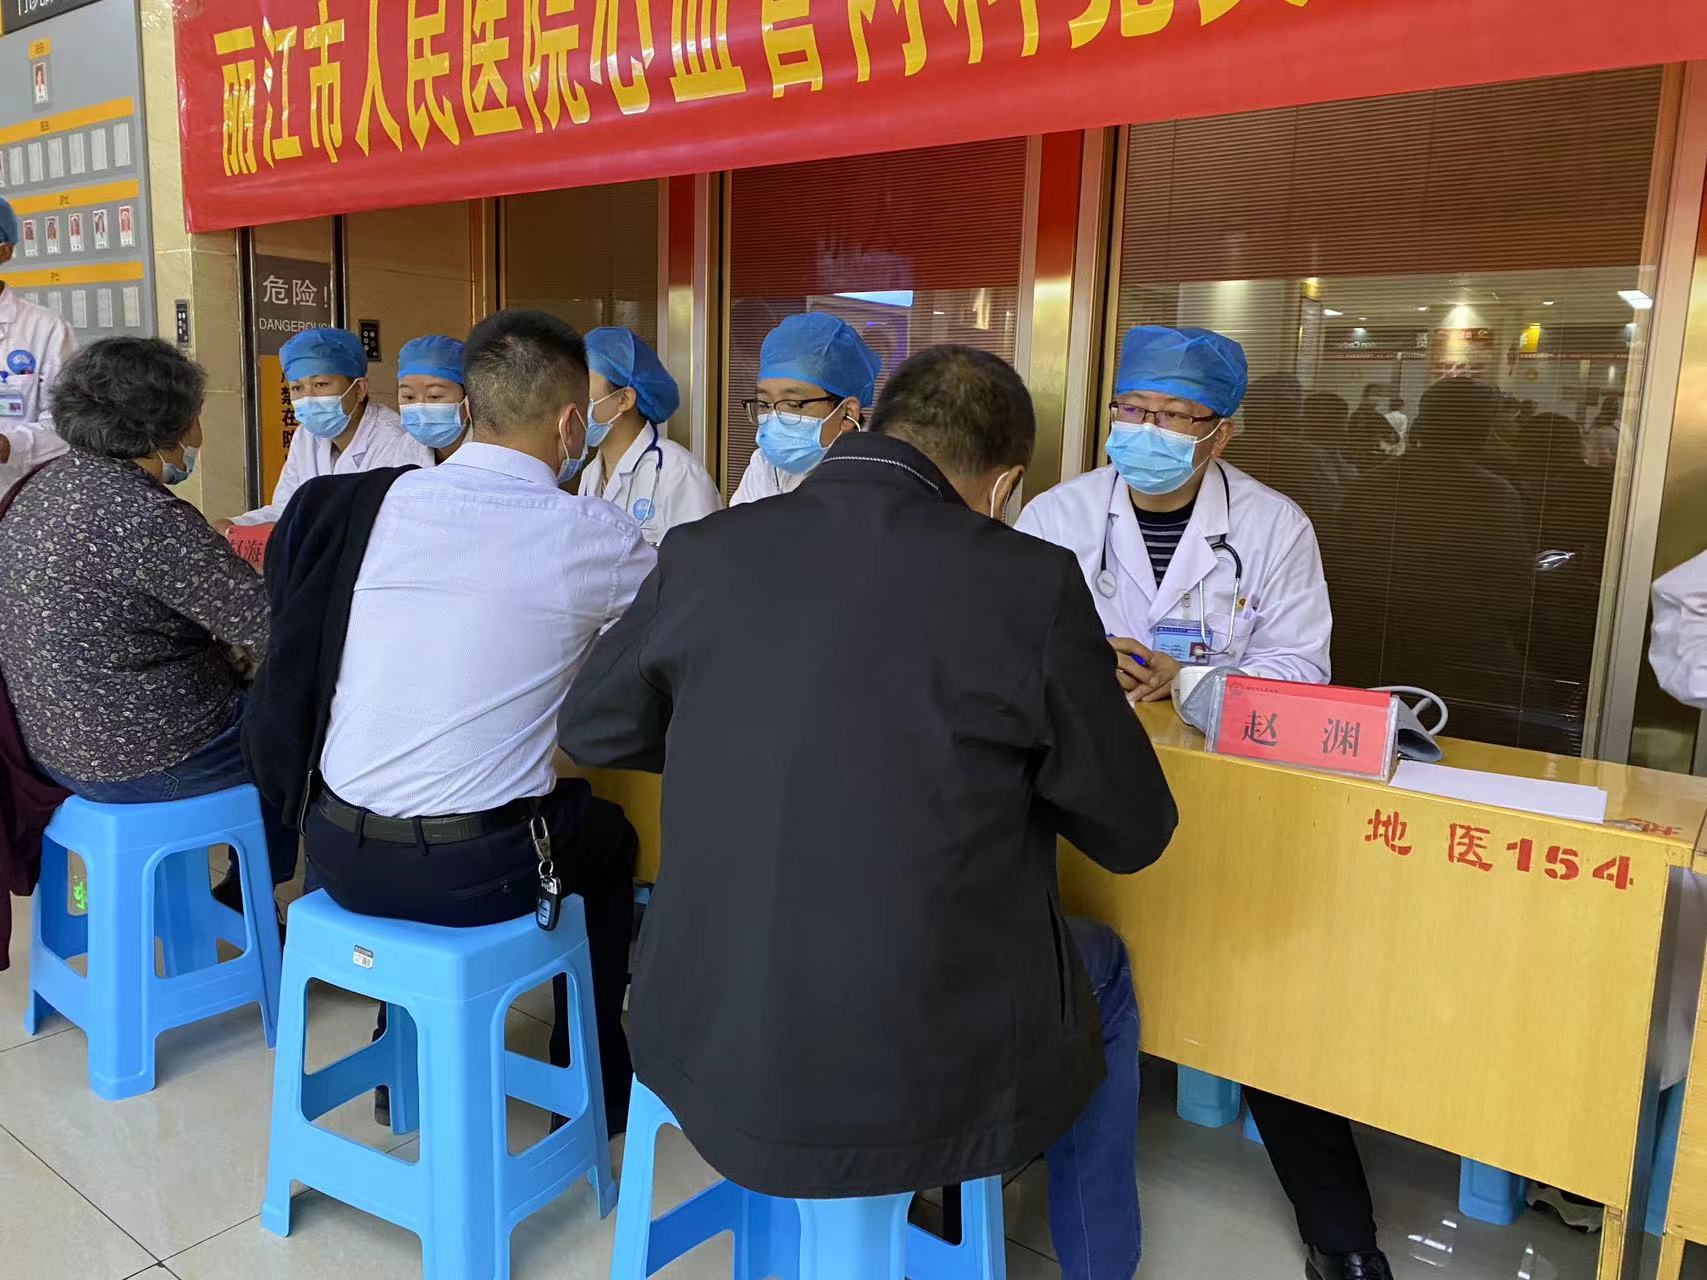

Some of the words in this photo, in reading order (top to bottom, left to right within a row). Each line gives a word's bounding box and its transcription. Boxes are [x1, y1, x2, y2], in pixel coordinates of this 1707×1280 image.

[213, 0, 1308, 176] 丽江市人民医院心血管
[262, 274, 328, 308] 危险!
[1241, 709, 1279, 747] 赵
[1322, 717, 1361, 757] 渊
[1364, 809, 1412, 855] 地
